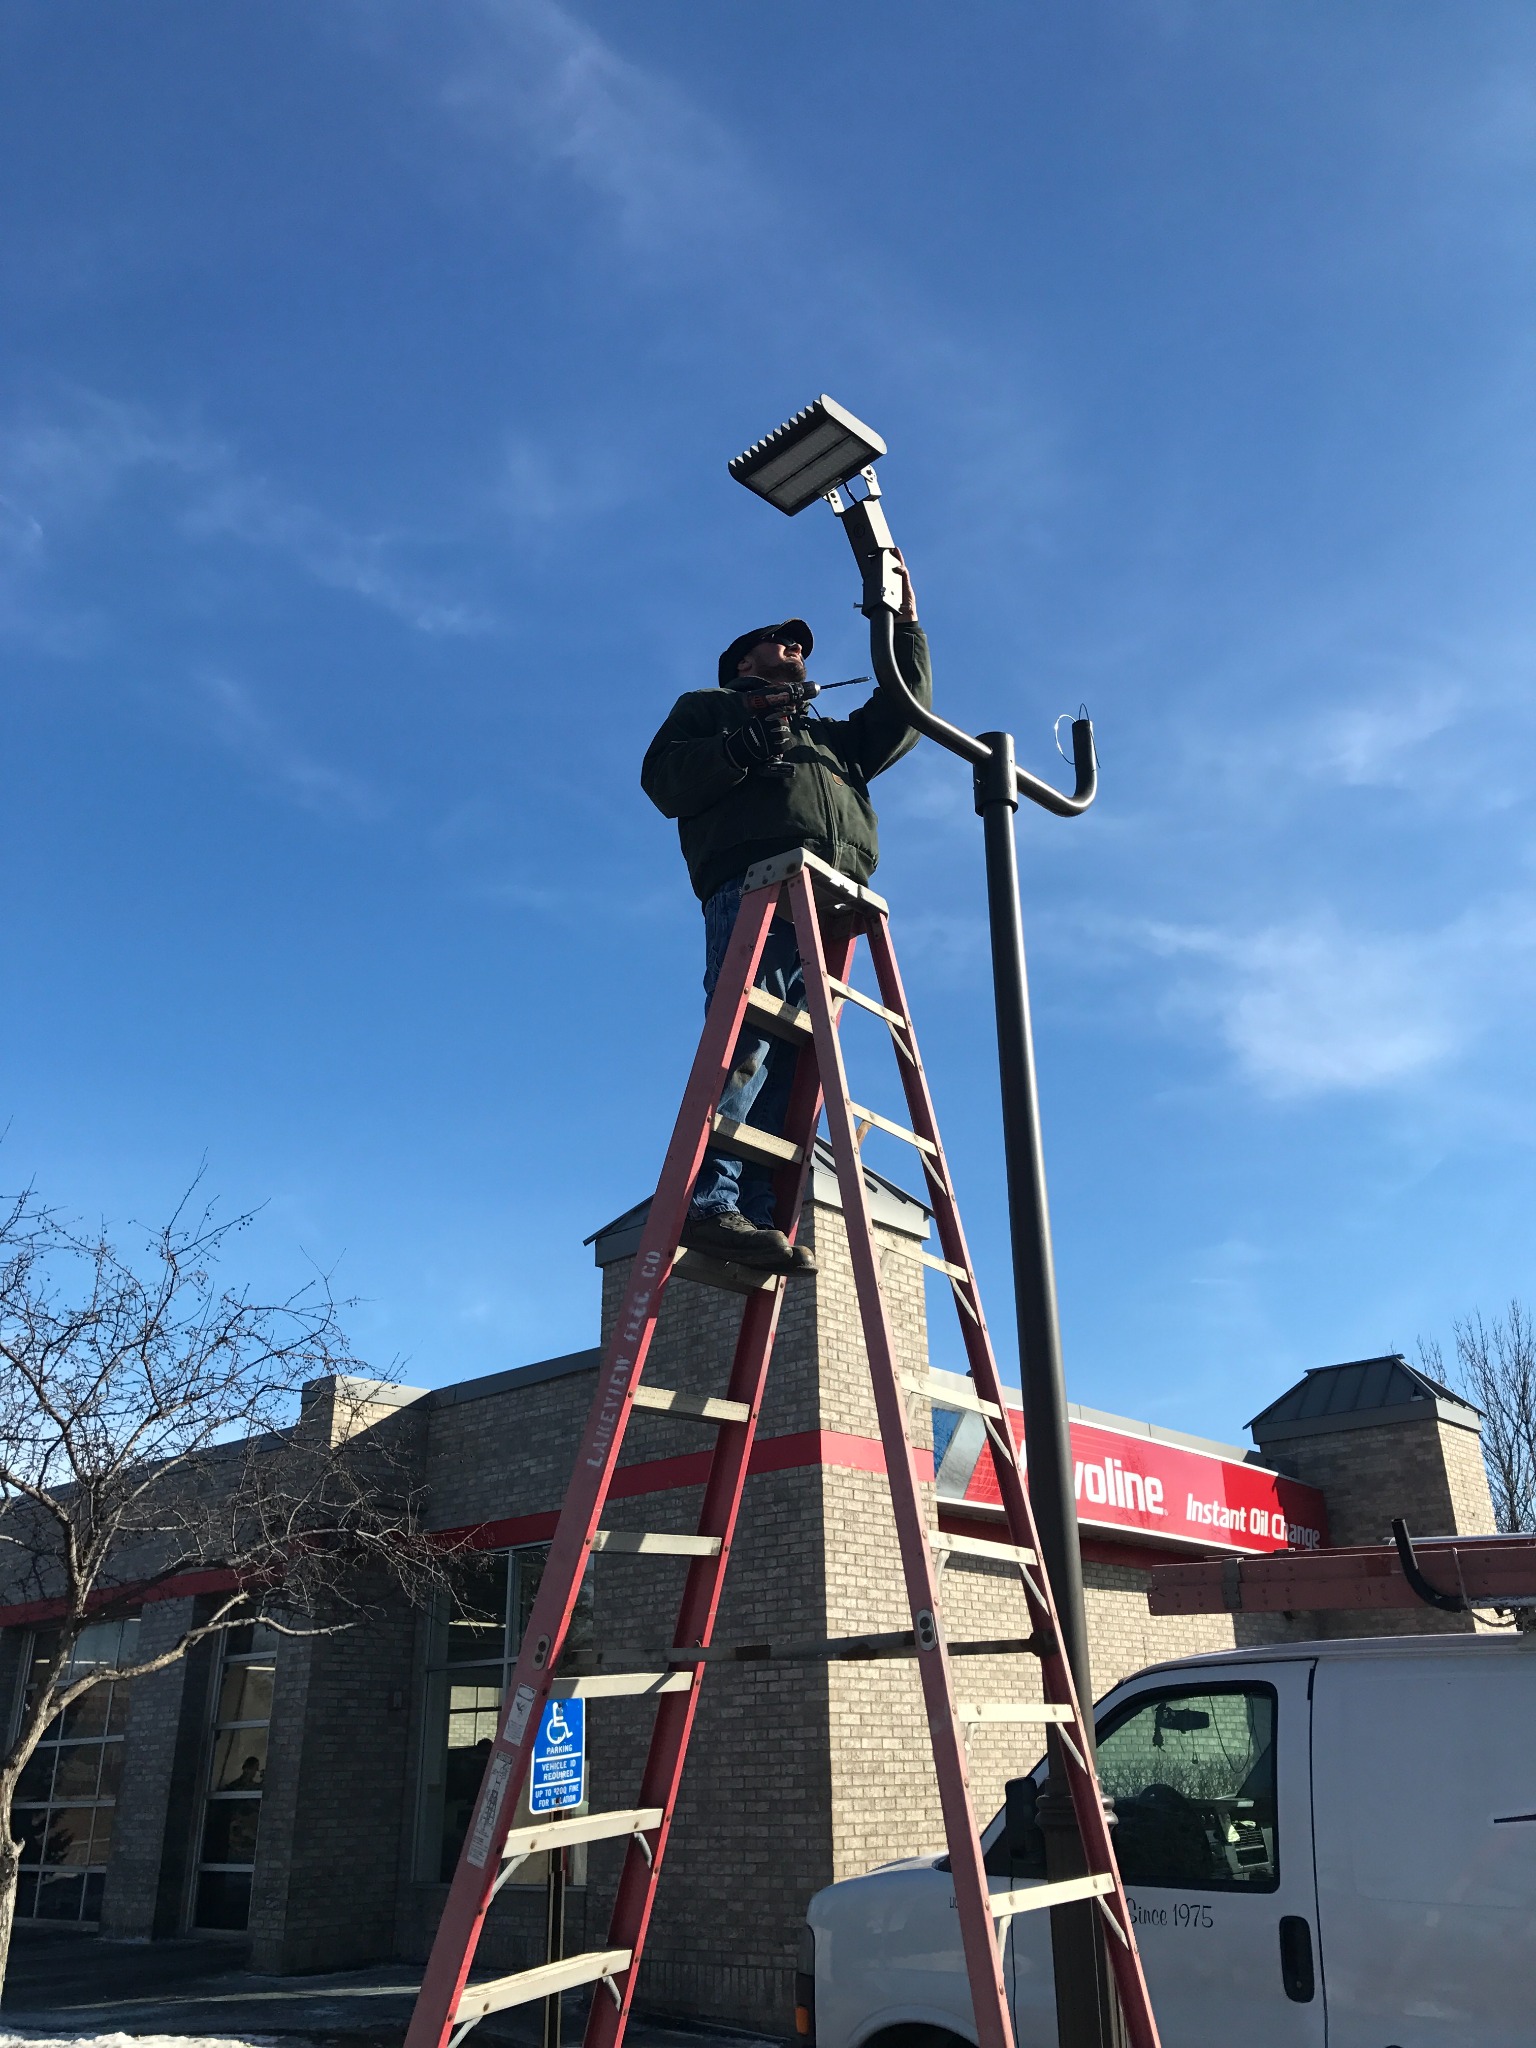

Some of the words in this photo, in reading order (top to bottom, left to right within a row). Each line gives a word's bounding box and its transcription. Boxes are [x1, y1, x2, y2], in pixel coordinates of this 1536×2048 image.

[587, 1355, 630, 1468] LAKEVIEW
[1186, 1493, 1247, 1532] Instant
[1250, 1508, 1269, 1537] Oil
[1271, 1514, 1320, 1550] Change
[546, 1744, 573, 1755] PARKING
[542, 1761, 568, 1771] VEHICLE
[570, 1759, 577, 1768] ID
[543, 1769, 574, 1781] REQUIRED
[535, 1790, 543, 1798] UP
[545, 1788, 552, 1797] TO
[569, 1784, 579, 1793] FINE
[538, 1799, 549, 1808] FOR
[552, 1794, 577, 1806] VILATION
[1126, 1898, 1167, 1926] Since
[1173, 1903, 1214, 1928] 1975
